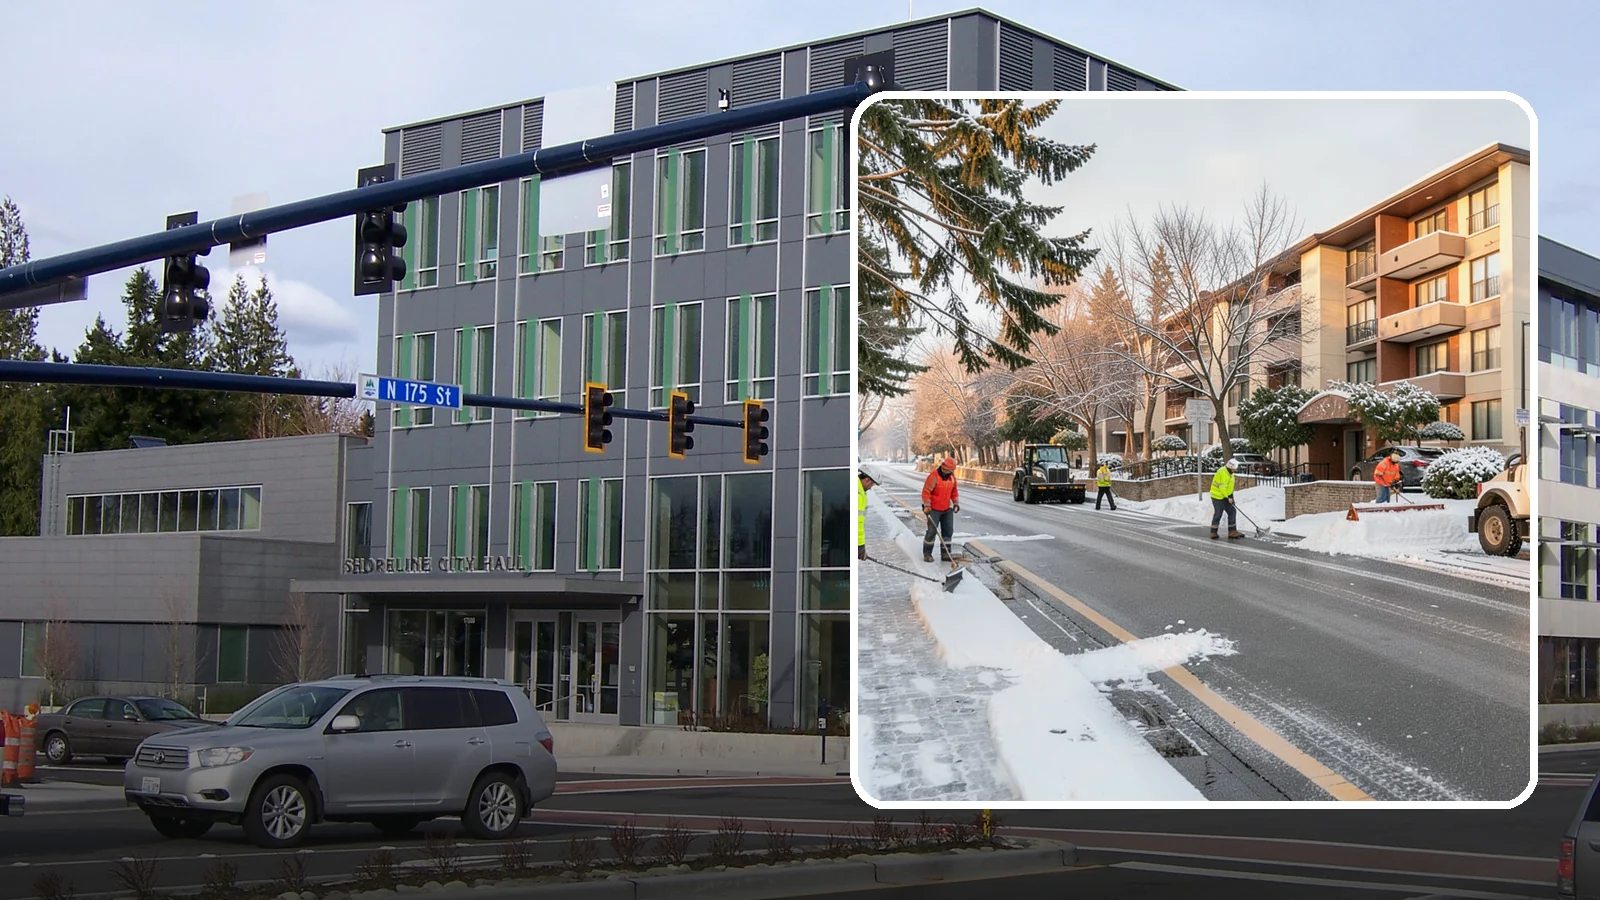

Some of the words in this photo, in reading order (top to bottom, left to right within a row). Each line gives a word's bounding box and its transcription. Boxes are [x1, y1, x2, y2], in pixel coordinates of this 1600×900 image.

[387, 380, 396, 400] N
[405, 382, 428, 403] 175
[436, 386, 451, 406] St
[344, 557, 432, 574] SHORELINE
[438, 556, 475, 573] CITY
[483, 555, 525, 572] HALL
